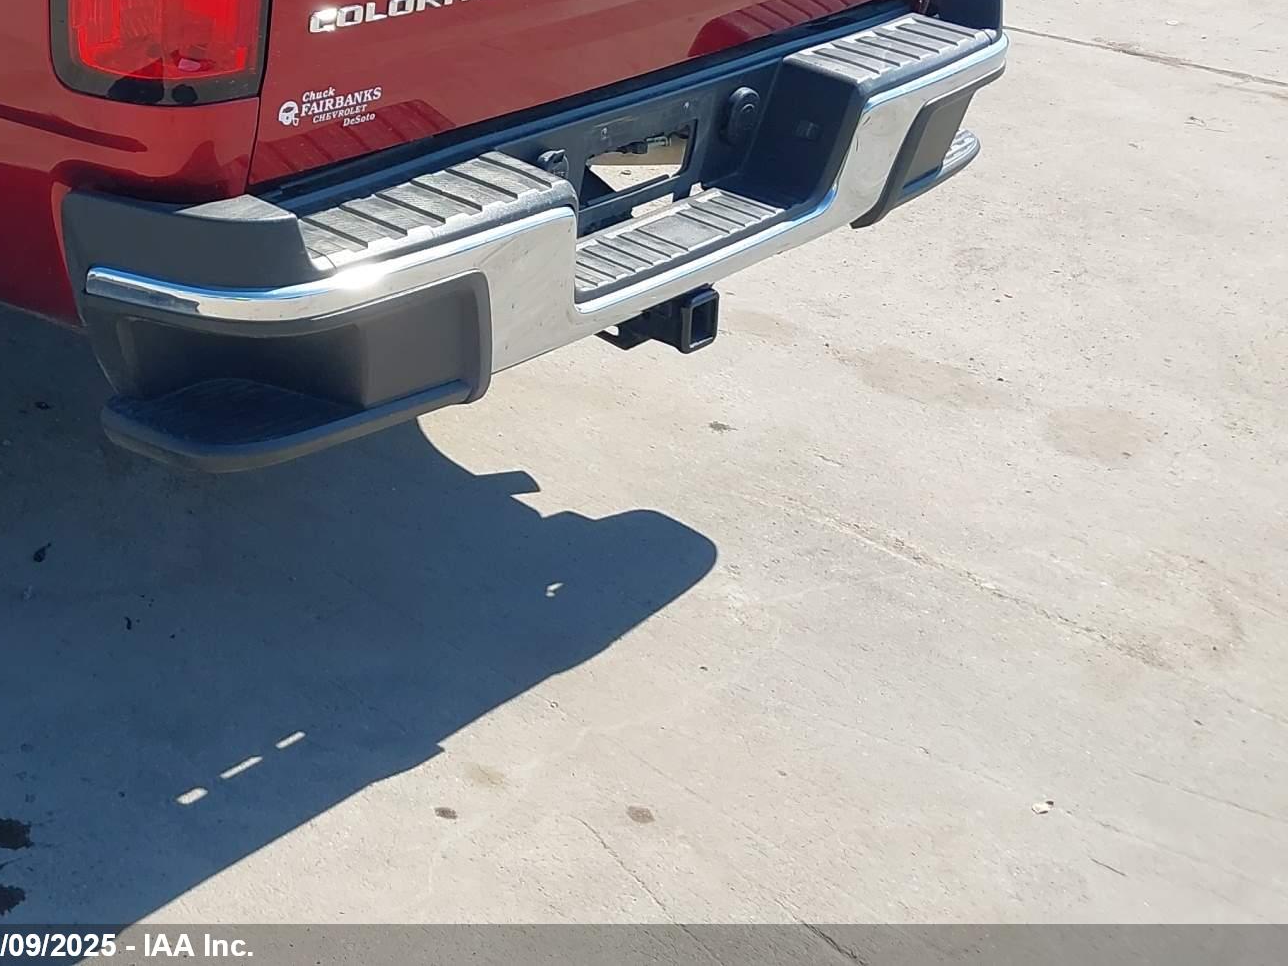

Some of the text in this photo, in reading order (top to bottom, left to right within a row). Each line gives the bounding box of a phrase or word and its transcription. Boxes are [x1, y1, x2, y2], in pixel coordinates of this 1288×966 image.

[301, 87, 382, 117] FAIRBANKS
[302, 87, 335, 102] Chuck
[312, 104, 367, 124] CHEVROLET
[343, 113, 376, 127] DeSoto
